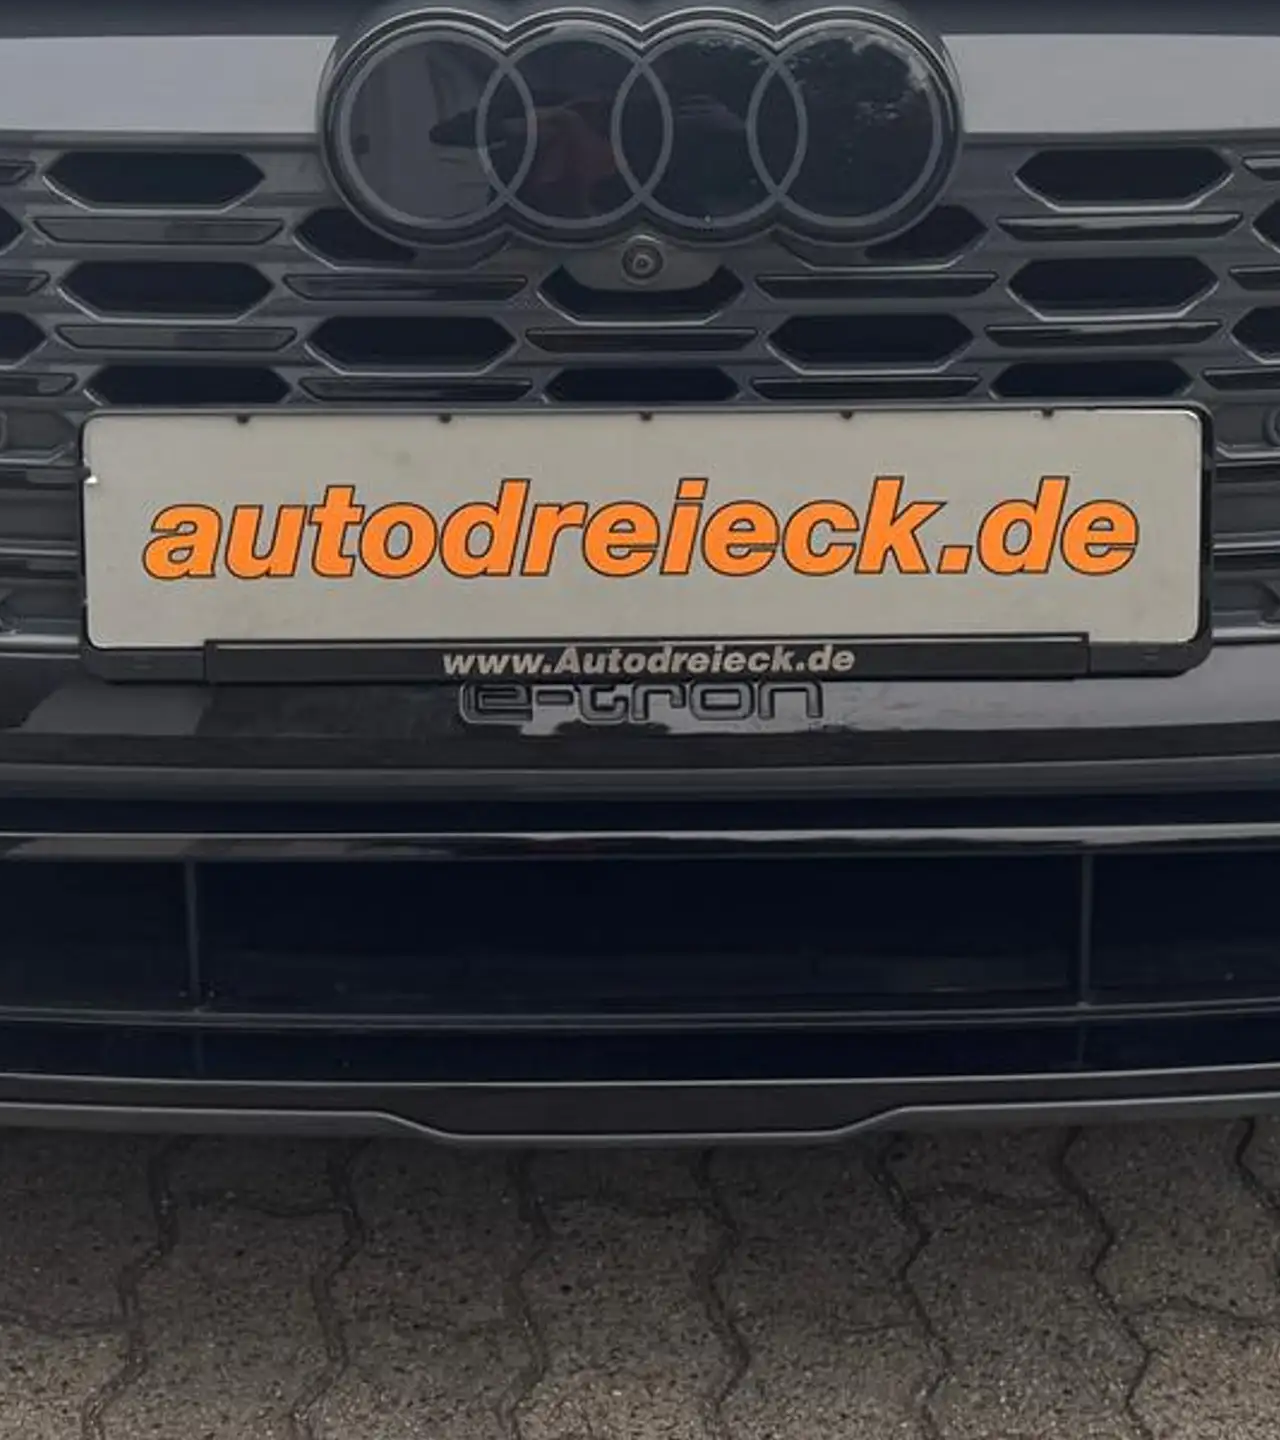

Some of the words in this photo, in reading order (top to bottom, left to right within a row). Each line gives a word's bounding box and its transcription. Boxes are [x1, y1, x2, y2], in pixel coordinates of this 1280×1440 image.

[143, 476, 1139, 579] autodreieck.de
[442, 644, 856, 675] www.Autodreieck.de
[460, 681, 824, 724] e-tron
